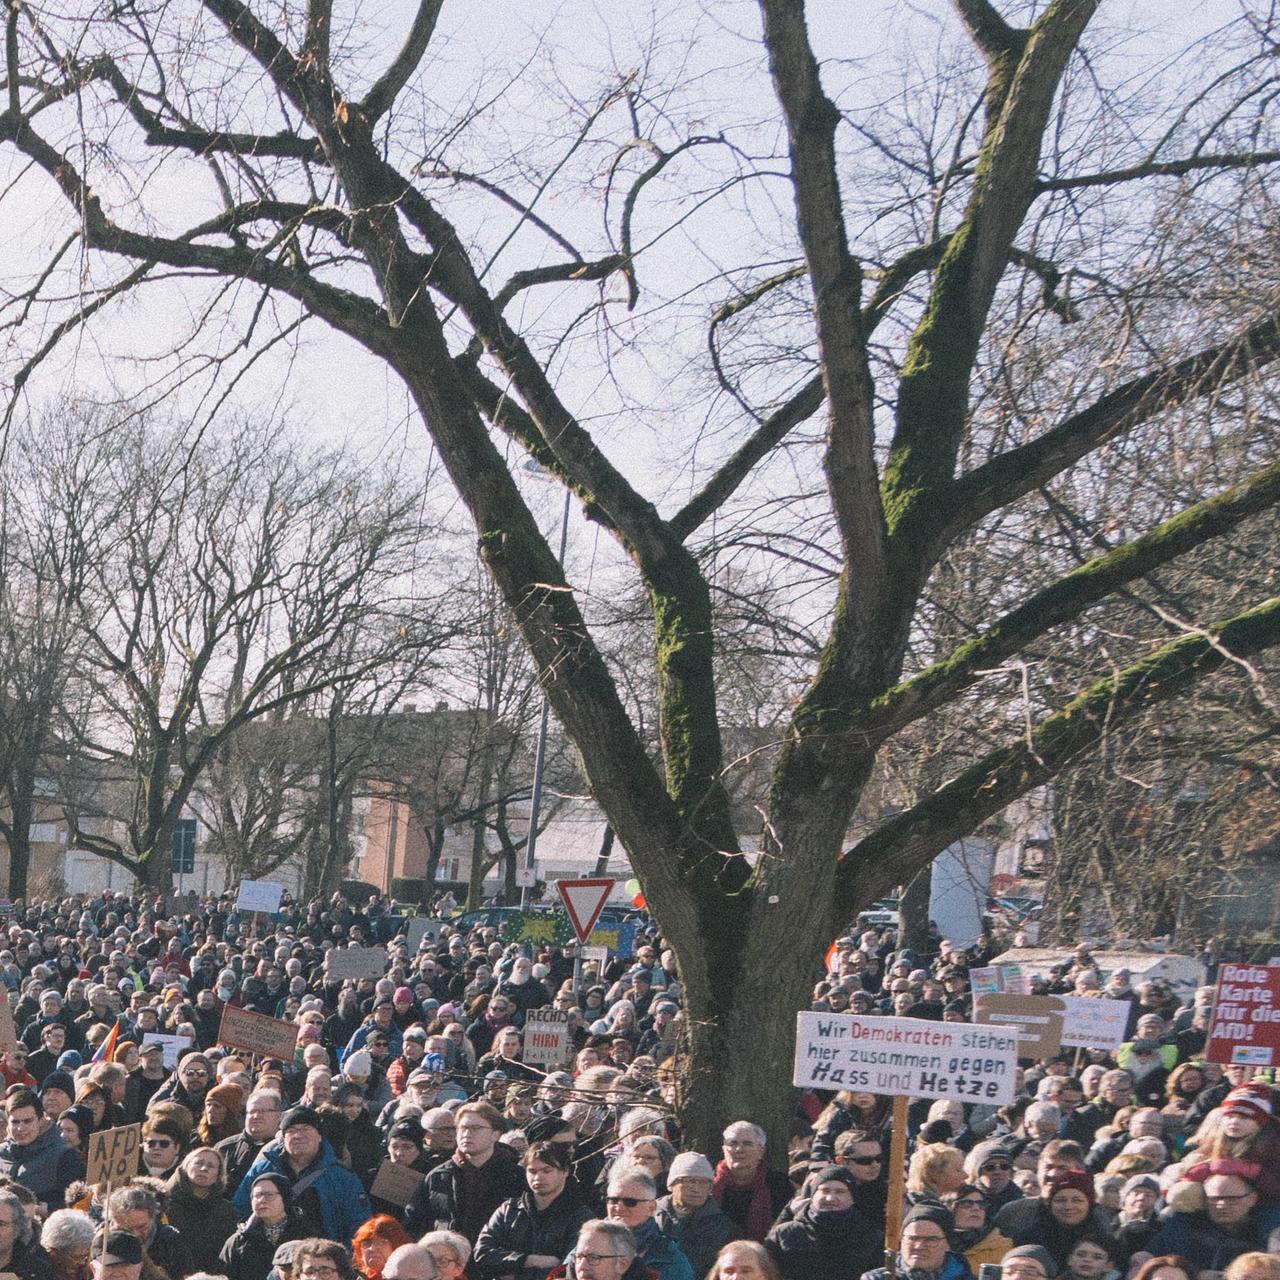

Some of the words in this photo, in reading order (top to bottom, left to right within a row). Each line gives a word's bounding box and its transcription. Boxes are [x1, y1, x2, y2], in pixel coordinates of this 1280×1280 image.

[1223, 966, 1269, 983] Rote
[1220, 984, 1273, 1002] Karte
[527, 1010, 568, 1024] RECHTS
[1216, 1003, 1247, 1020] für
[1251, 1005, 1280, 1022] die
[532, 1034, 559, 1047] HIRN
[818, 1020, 846, 1038] Wir
[852, 1022, 953, 1045] Demokraten
[961, 1032, 1016, 1050] stehen
[1211, 1023, 1255, 1041] AfD!
[807, 1042, 839, 1060] hier
[849, 1050, 941, 1068] zusammen
[949, 1057, 1006, 1075] gegen
[811, 1063, 868, 1085] Hass
[877, 1072, 911, 1090] und
[920, 1072, 999, 1098] Hetze
[94, 1128, 136, 1162] AFD
[99, 1158, 126, 1182] NO
